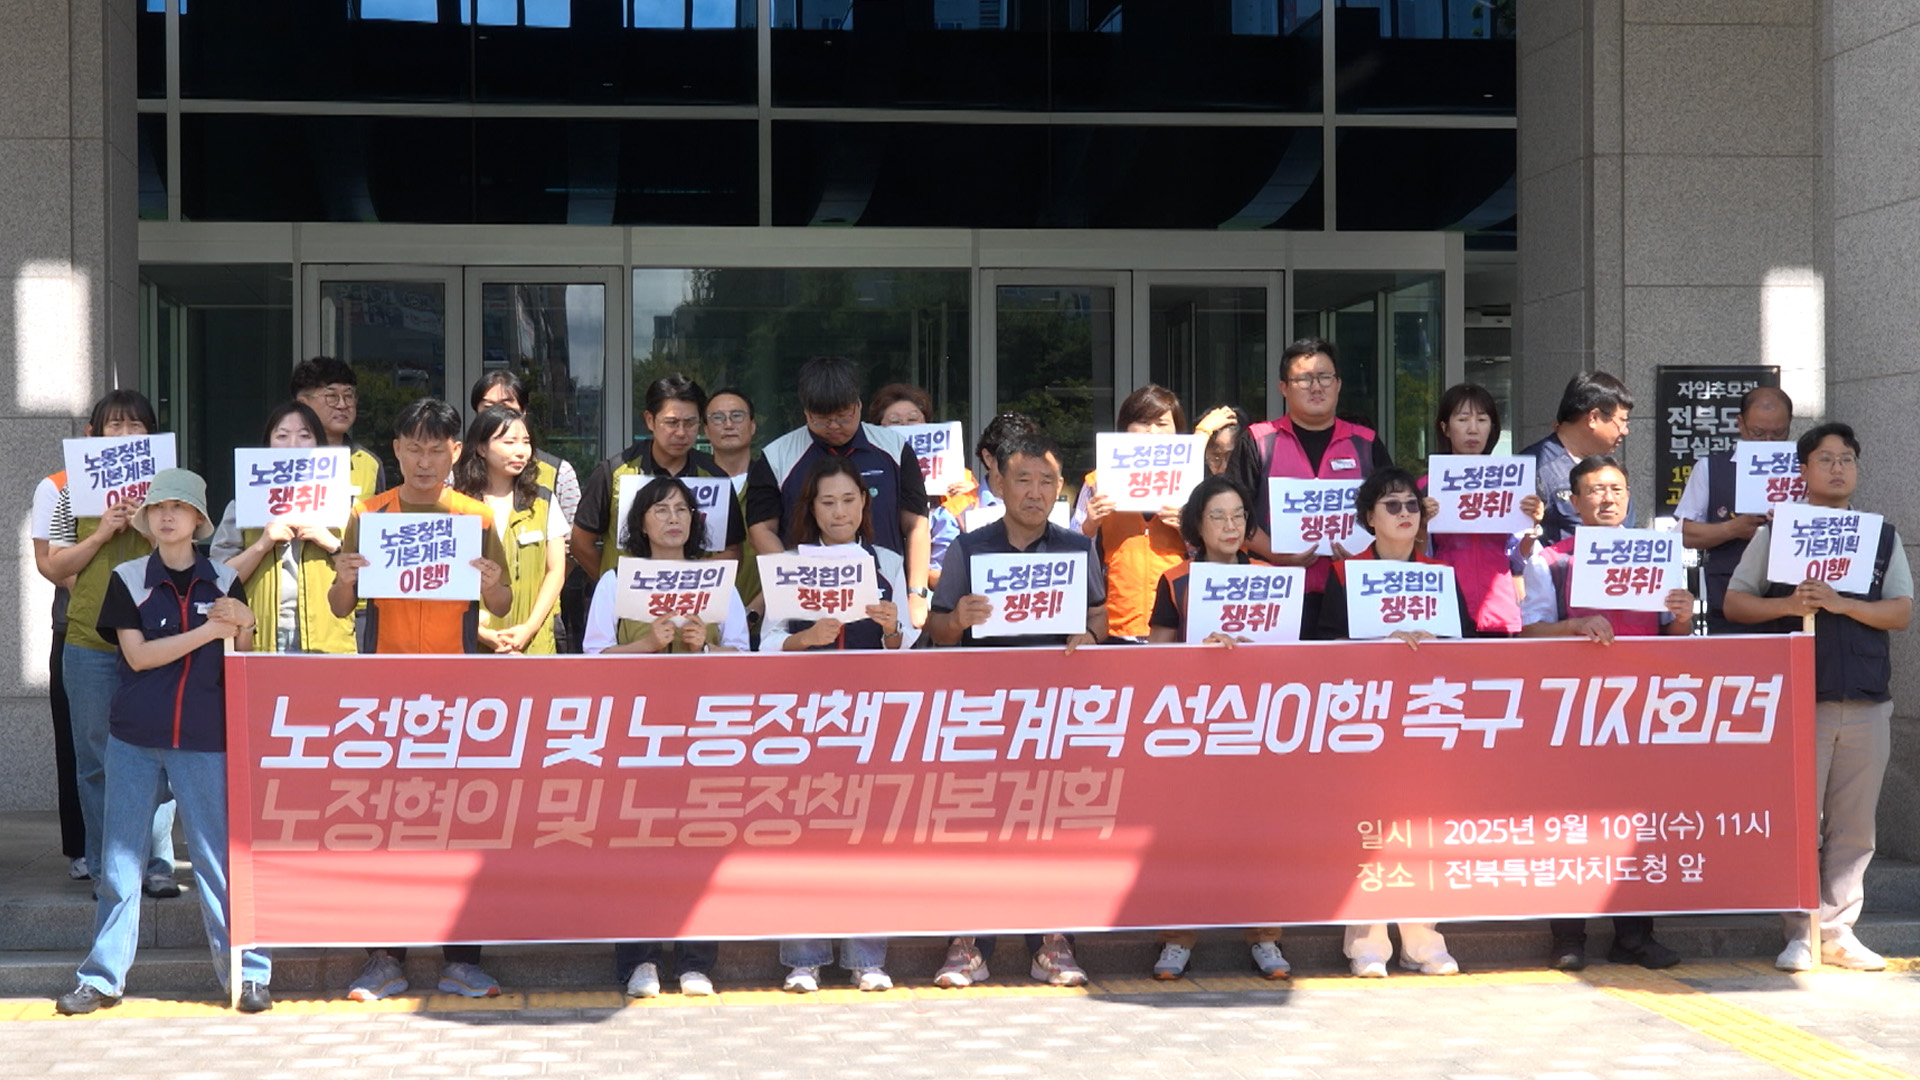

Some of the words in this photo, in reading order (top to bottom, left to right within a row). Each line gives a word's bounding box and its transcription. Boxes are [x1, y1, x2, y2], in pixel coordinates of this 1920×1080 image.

[1667, 405, 1741, 436] 전북도
[84, 437, 152, 472] 노동정책
[1111, 443, 1192, 469] 노정협의
[90, 457, 156, 490] 기본계획
[249, 456, 337, 487] 노정협의
[1128, 470, 1182, 498] 쟁취!
[1441, 463, 1525, 491] 노정협의
[268, 484, 327, 516] 쟁취!
[1457, 490, 1513, 521] 쟁취!
[380, 517, 453, 549] 노동정책
[1300, 512, 1355, 542] 쟁취!
[1791, 515, 1860, 538] 노동정책
[384, 538, 457, 569] 기본계획
[1587, 539, 1673, 565] 노정협의
[1793, 535, 1860, 558] 기본계획
[399, 563, 450, 593] 이행!
[629, 566, 726, 591] 노정협의
[775, 564, 863, 588] 노정협의
[984, 559, 1076, 595] 노정협의
[1360, 571, 1443, 597] 노정협의
[1604, 566, 1664, 596] 쟁취!
[1806, 557, 1852, 582] 이행!
[796, 587, 854, 612] 쟁취!
[1202, 575, 1293, 601] 노정협의
[648, 591, 710, 617] 쟁취!
[1003, 589, 1064, 623] 쟁취!
[1219, 602, 1281, 632] 쟁취!
[1380, 596, 1437, 623] 쟁취!
[259, 694, 533, 769] 노정협의
[542, 695, 614, 769] 및
[617, 684, 1135, 768] 노동정책기본계획
[1143, 679, 1394, 758] 성실이행
[1401, 676, 1525, 750] 촉구
[1540, 673, 1784, 747] 기자회견
[251, 776, 524, 852] 노정협의
[533, 778, 605, 850] 및
[608, 766, 1125, 848] 노동정책기본계획
[1356, 819, 1413, 850] 일시
[1443, 815, 1535, 846] 2025년
[1544, 814, 1589, 845] 9월
[1600, 810, 1706, 843] 10일(수)
[1715, 809, 1771, 840] 11시
[1356, 860, 1415, 892] 장소
[1443, 853, 1669, 890] 전북특별자치도청
[1678, 853, 1707, 884] 앞
